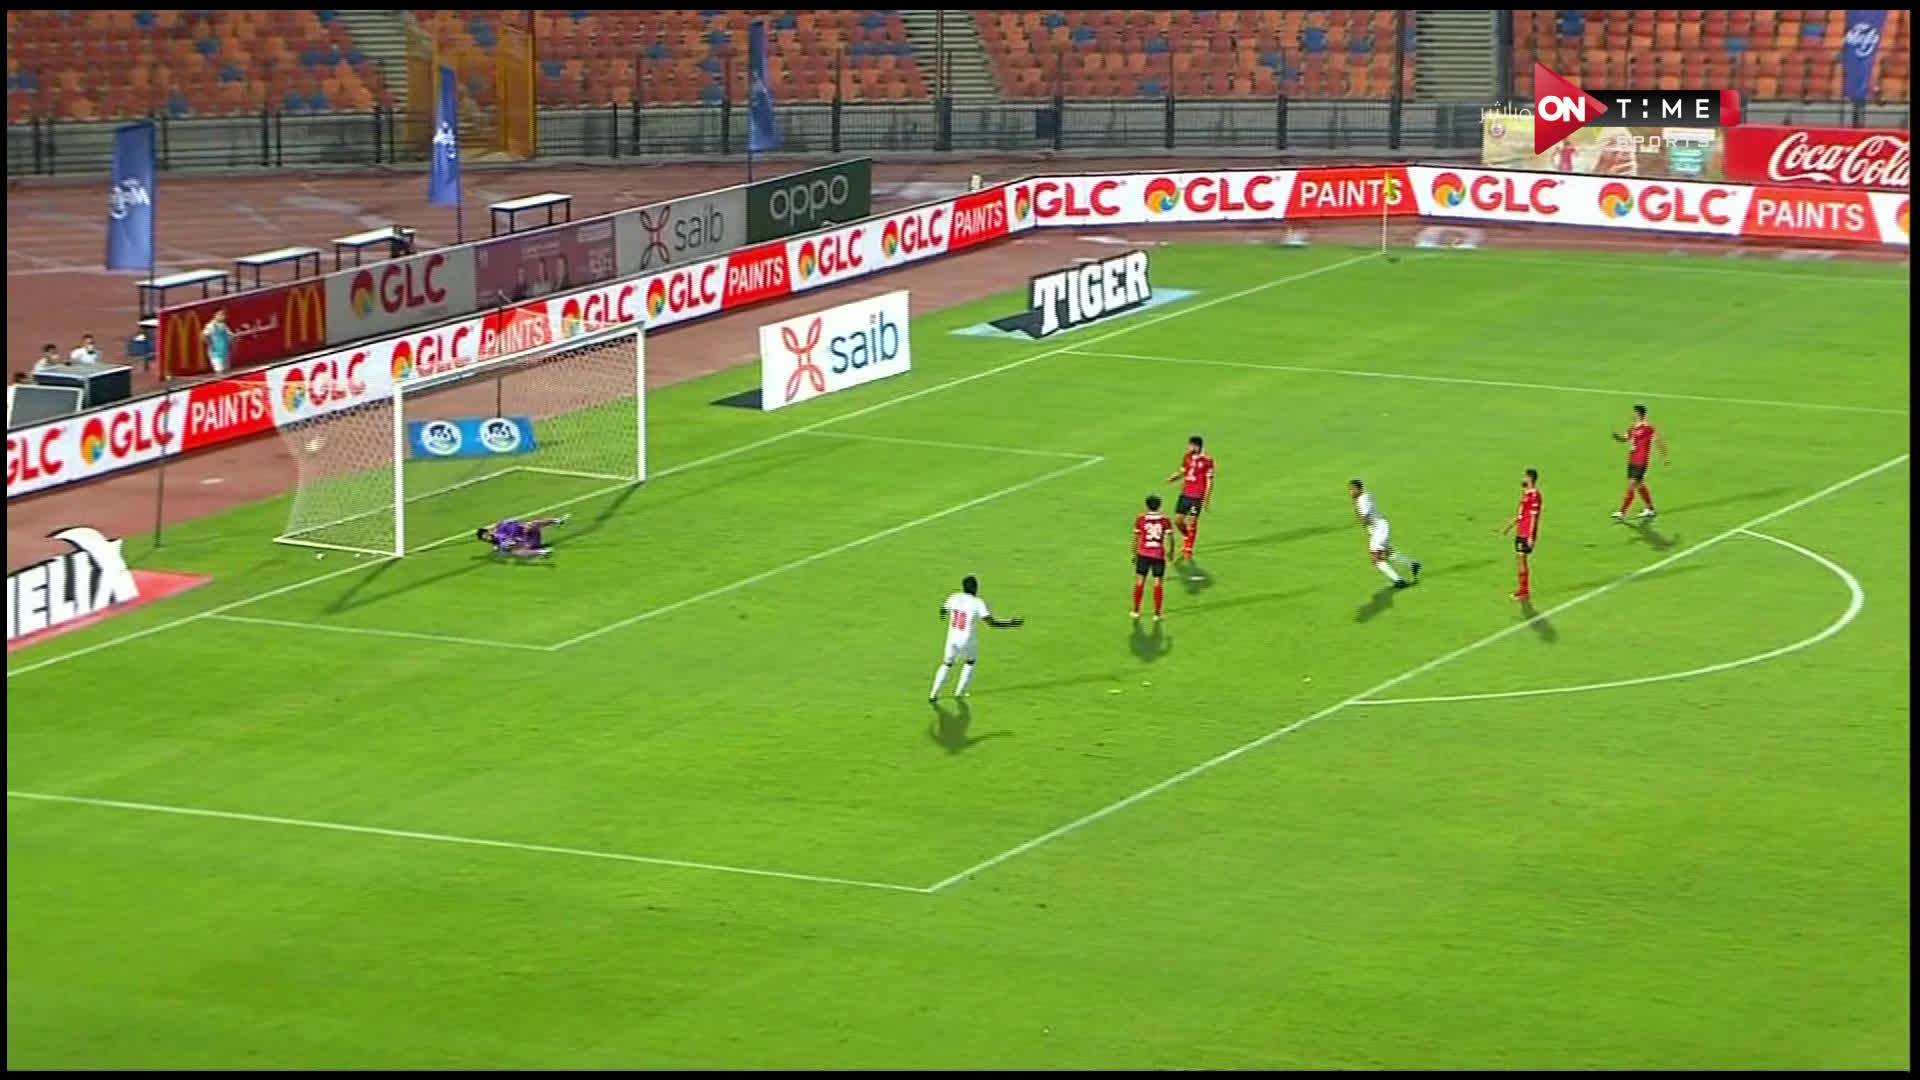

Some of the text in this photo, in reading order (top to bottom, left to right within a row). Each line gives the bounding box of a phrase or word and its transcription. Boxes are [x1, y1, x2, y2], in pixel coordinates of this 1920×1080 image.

[1768, 133, 1910, 186] Coca-Cola
[770, 174, 847, 225] oppo
[1033, 175, 1863, 231] GLC GLC PAINTS GLC GLC PAINTS
[675, 205, 723, 252] saib
[381, 254, 446, 312] GLC
[1035, 252, 1150, 336] TIGER
[111, 401, 173, 458] GLC
[191, 386, 263, 434] PAINTS
[309, 352, 366, 406] GLC
[416, 327, 469, 376] GLC
[584, 286, 634, 330] GLC
[668, 267, 717, 312] GLC
[730, 257, 784, 297] PAINTS
[818, 229, 863, 276] GLC
[902, 209, 943, 253] GLC
[955, 200, 1003, 239] PAINTS
[831, 310, 898, 374] saib
